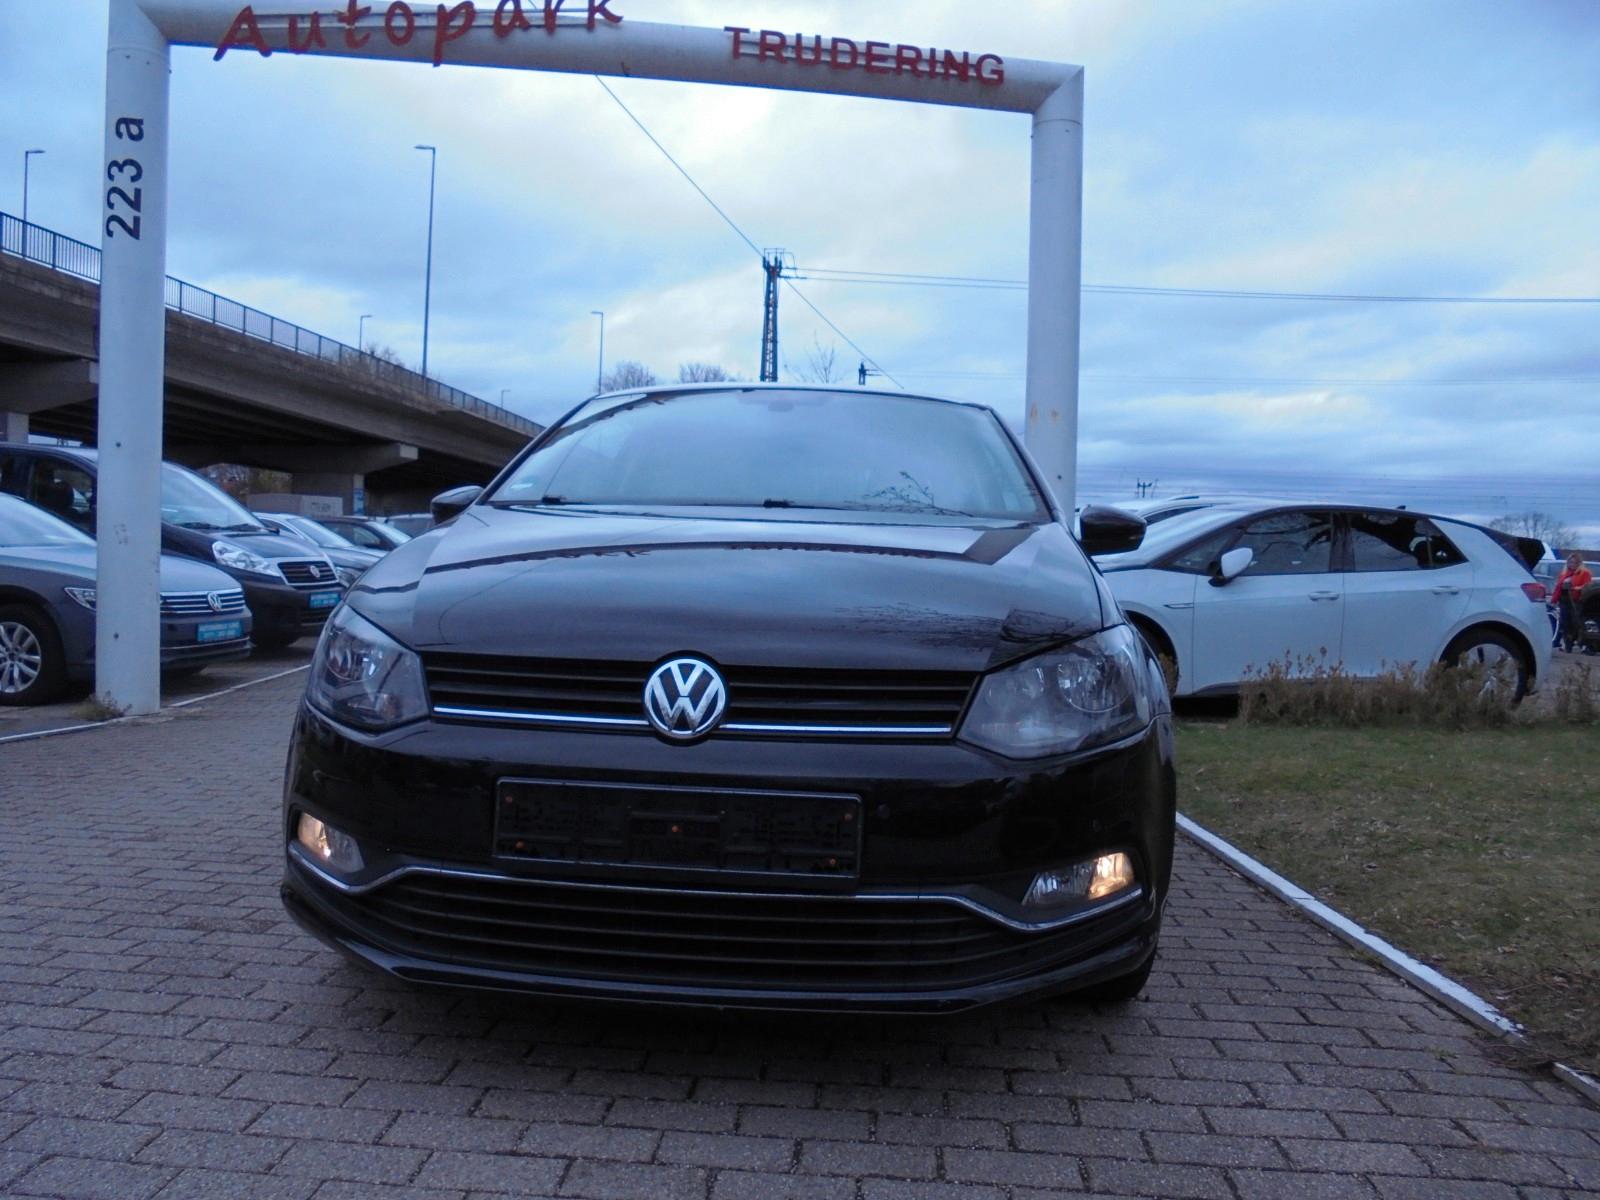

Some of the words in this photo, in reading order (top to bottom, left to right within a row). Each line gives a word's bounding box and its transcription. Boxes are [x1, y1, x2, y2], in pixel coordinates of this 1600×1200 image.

[724, 26, 1005, 86] TRUDERING
[115, 117, 144, 142] a
[106, 158, 143, 240] 223
[645, 659, 726, 737] VW
